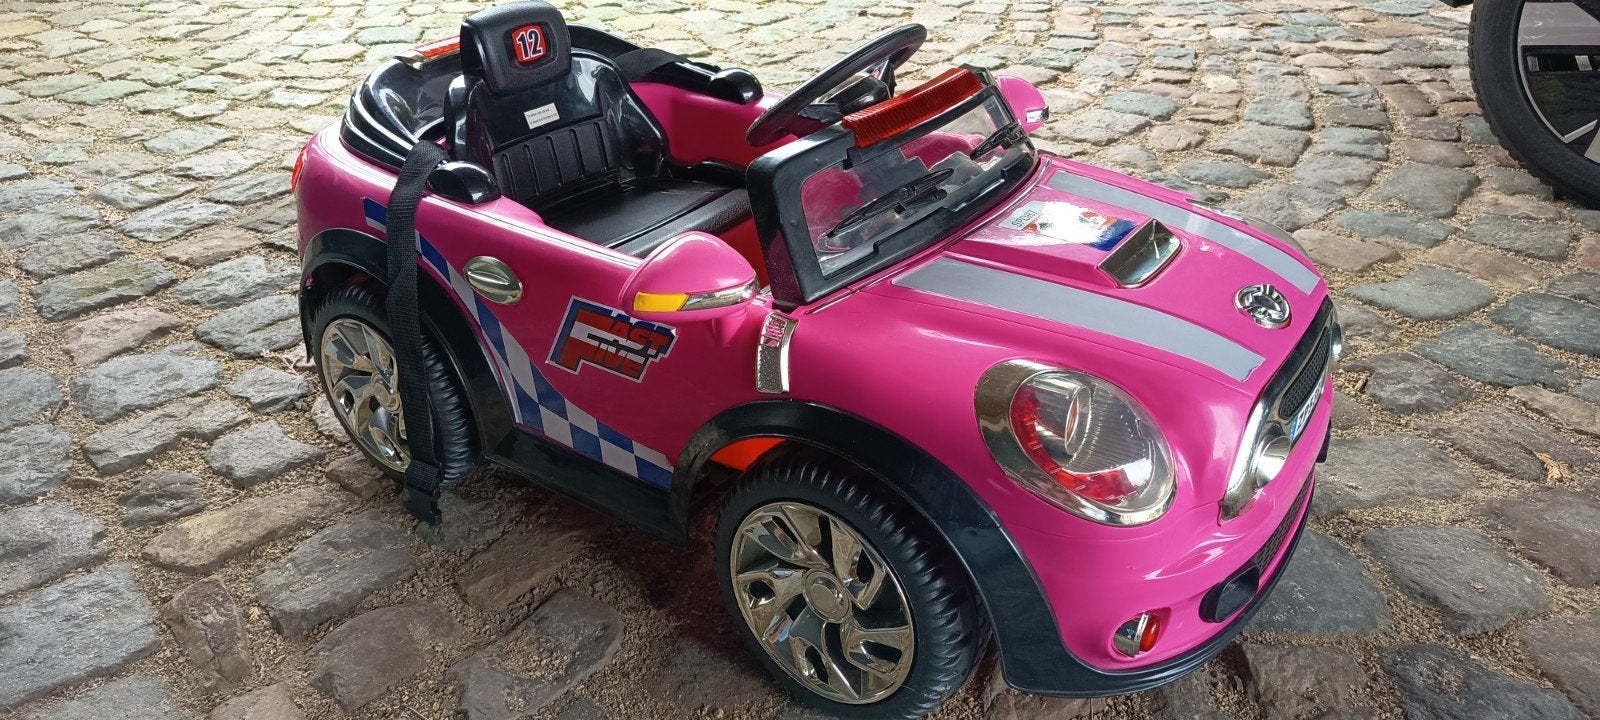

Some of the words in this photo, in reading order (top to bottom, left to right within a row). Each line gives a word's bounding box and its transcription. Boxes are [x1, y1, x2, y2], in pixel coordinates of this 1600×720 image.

[516, 29, 543, 60] 12
[566, 304, 672, 354] FAST
[555, 334, 646, 380] FIVE
